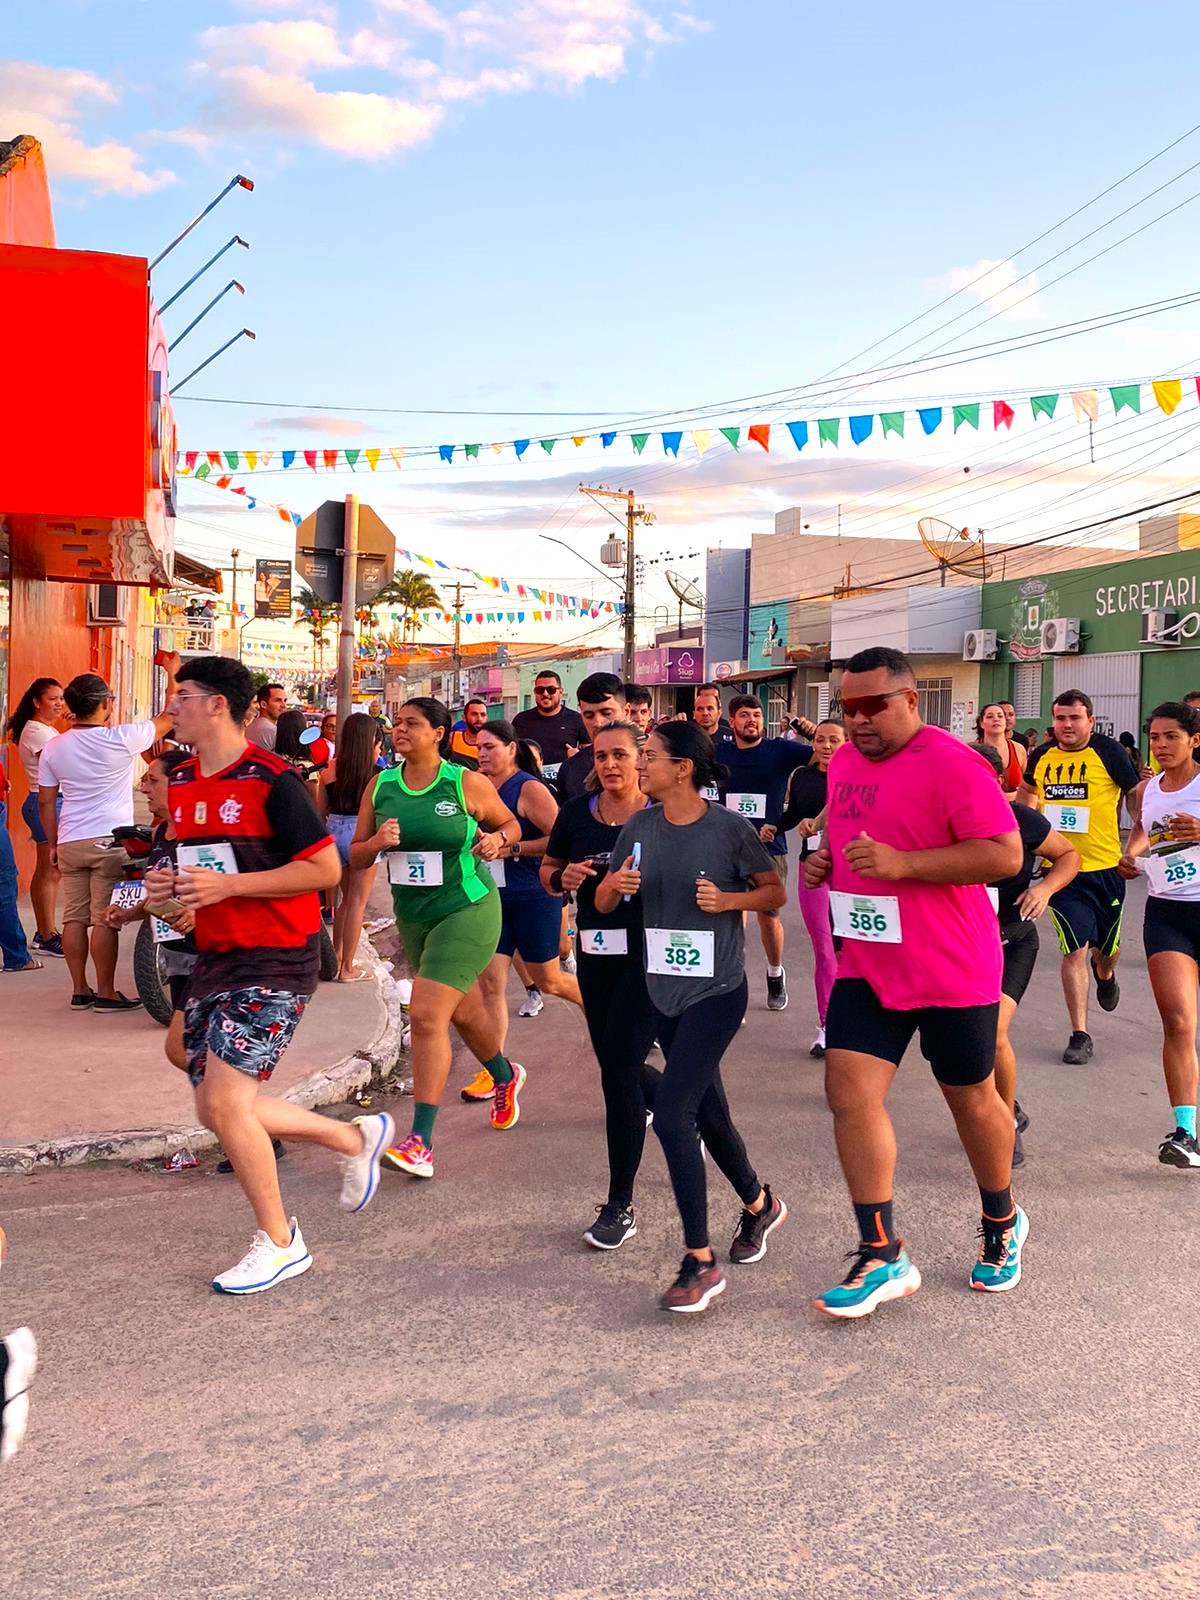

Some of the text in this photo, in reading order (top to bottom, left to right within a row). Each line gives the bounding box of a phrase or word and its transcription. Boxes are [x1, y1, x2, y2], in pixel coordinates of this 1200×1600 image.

[1095, 575, 1200, 616] SECRETARI
[738, 803, 757, 812] 351
[1060, 815, 1077, 826] 39
[409, 865, 425, 878] 21
[1165, 862, 1197, 882] 283
[119, 887, 142, 900] SKU
[849, 912, 887, 931] 386
[593, 931, 604, 946] 4
[664, 947, 701, 966] 382
